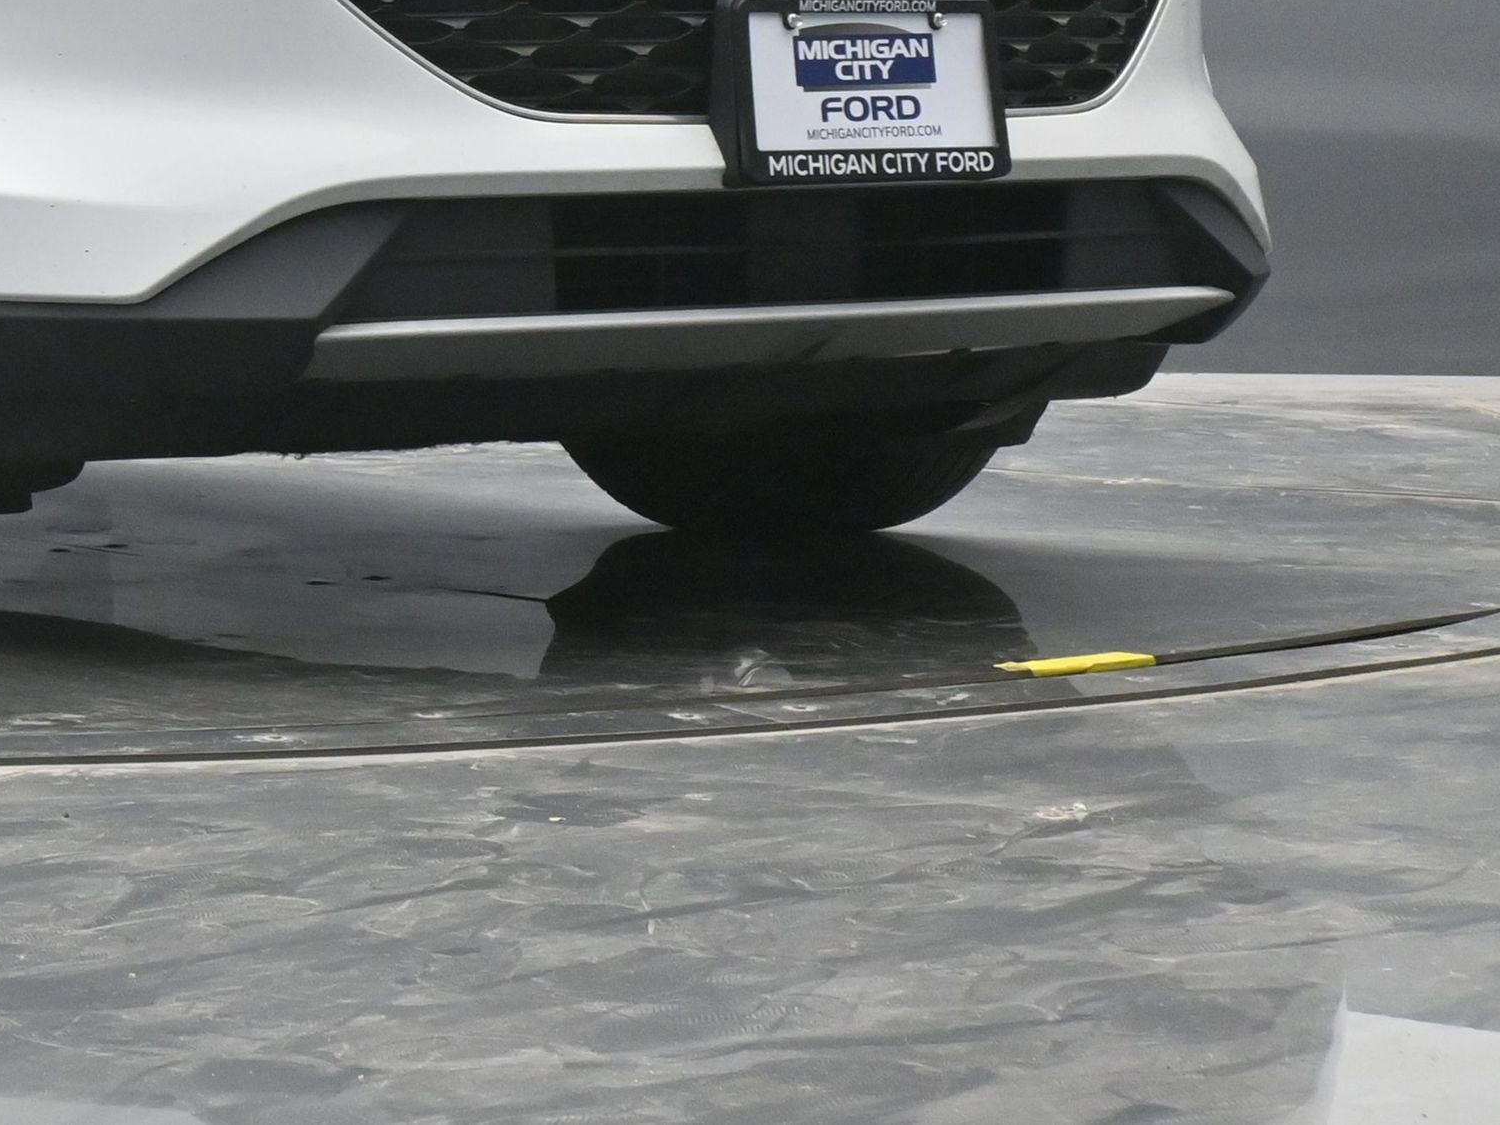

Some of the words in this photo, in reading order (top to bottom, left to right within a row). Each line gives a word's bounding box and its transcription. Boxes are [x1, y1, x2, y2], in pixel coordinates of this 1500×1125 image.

[797, 38, 930, 61] MICHIGAN
[834, 60, 894, 81] CITY
[820, 95, 921, 123] FORD
[807, 125, 942, 140] MICHIGANCITYFORD.COM
[768, 153, 877, 176] MICHIGAN
[882, 152, 930, 173] CITY
[935, 151, 994, 173] FORD
